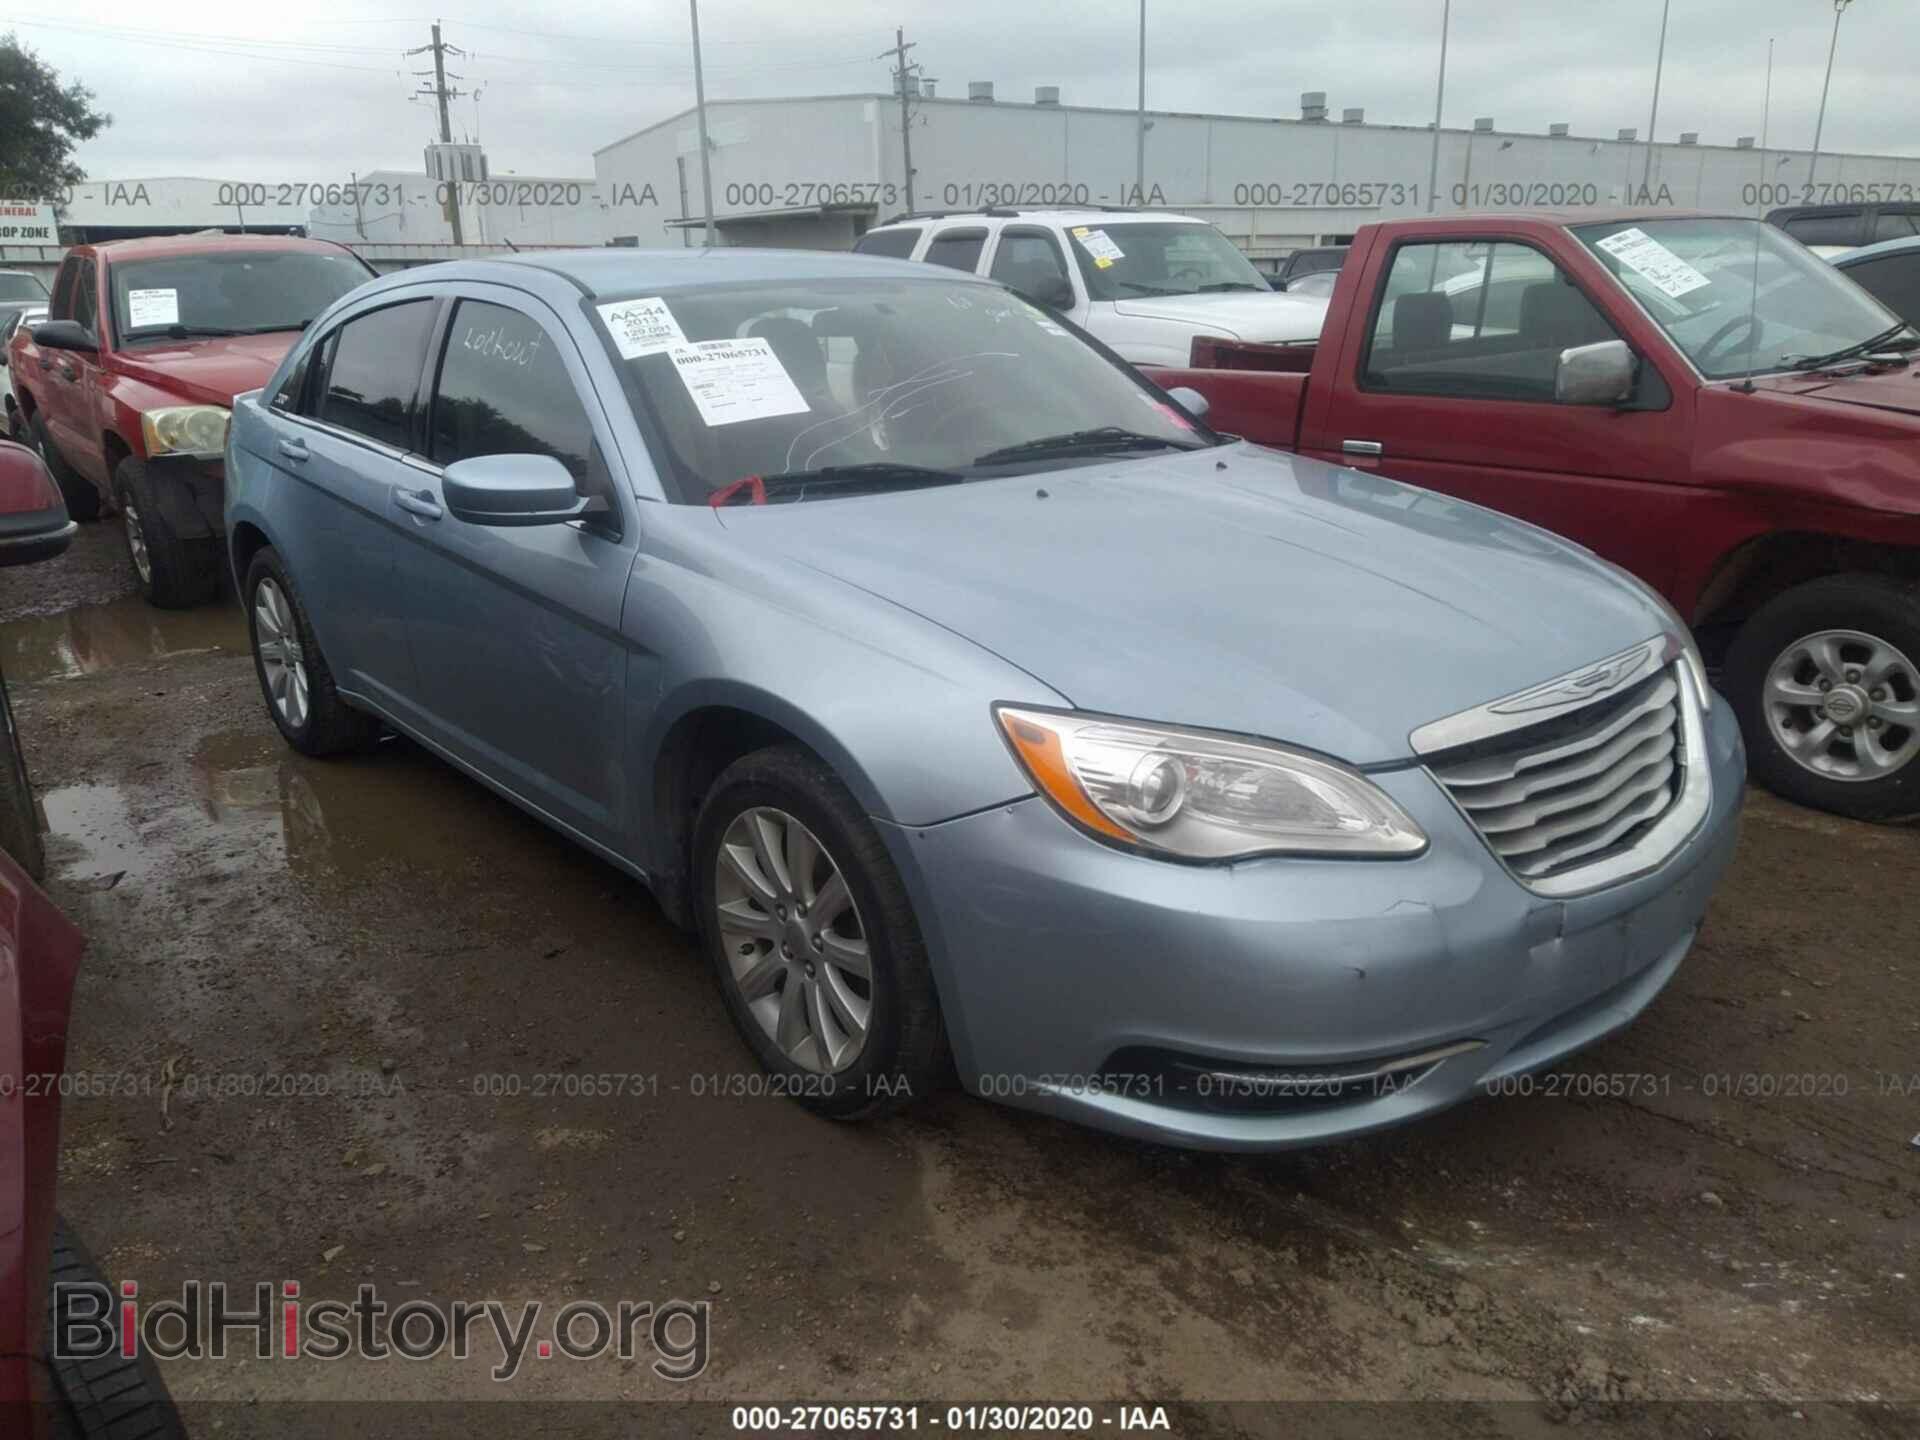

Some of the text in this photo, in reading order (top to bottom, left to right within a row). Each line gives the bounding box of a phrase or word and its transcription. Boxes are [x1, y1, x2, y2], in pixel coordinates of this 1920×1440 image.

[0, 226, 49, 238] OP ZONE
[610, 306, 665, 323] AA-44
